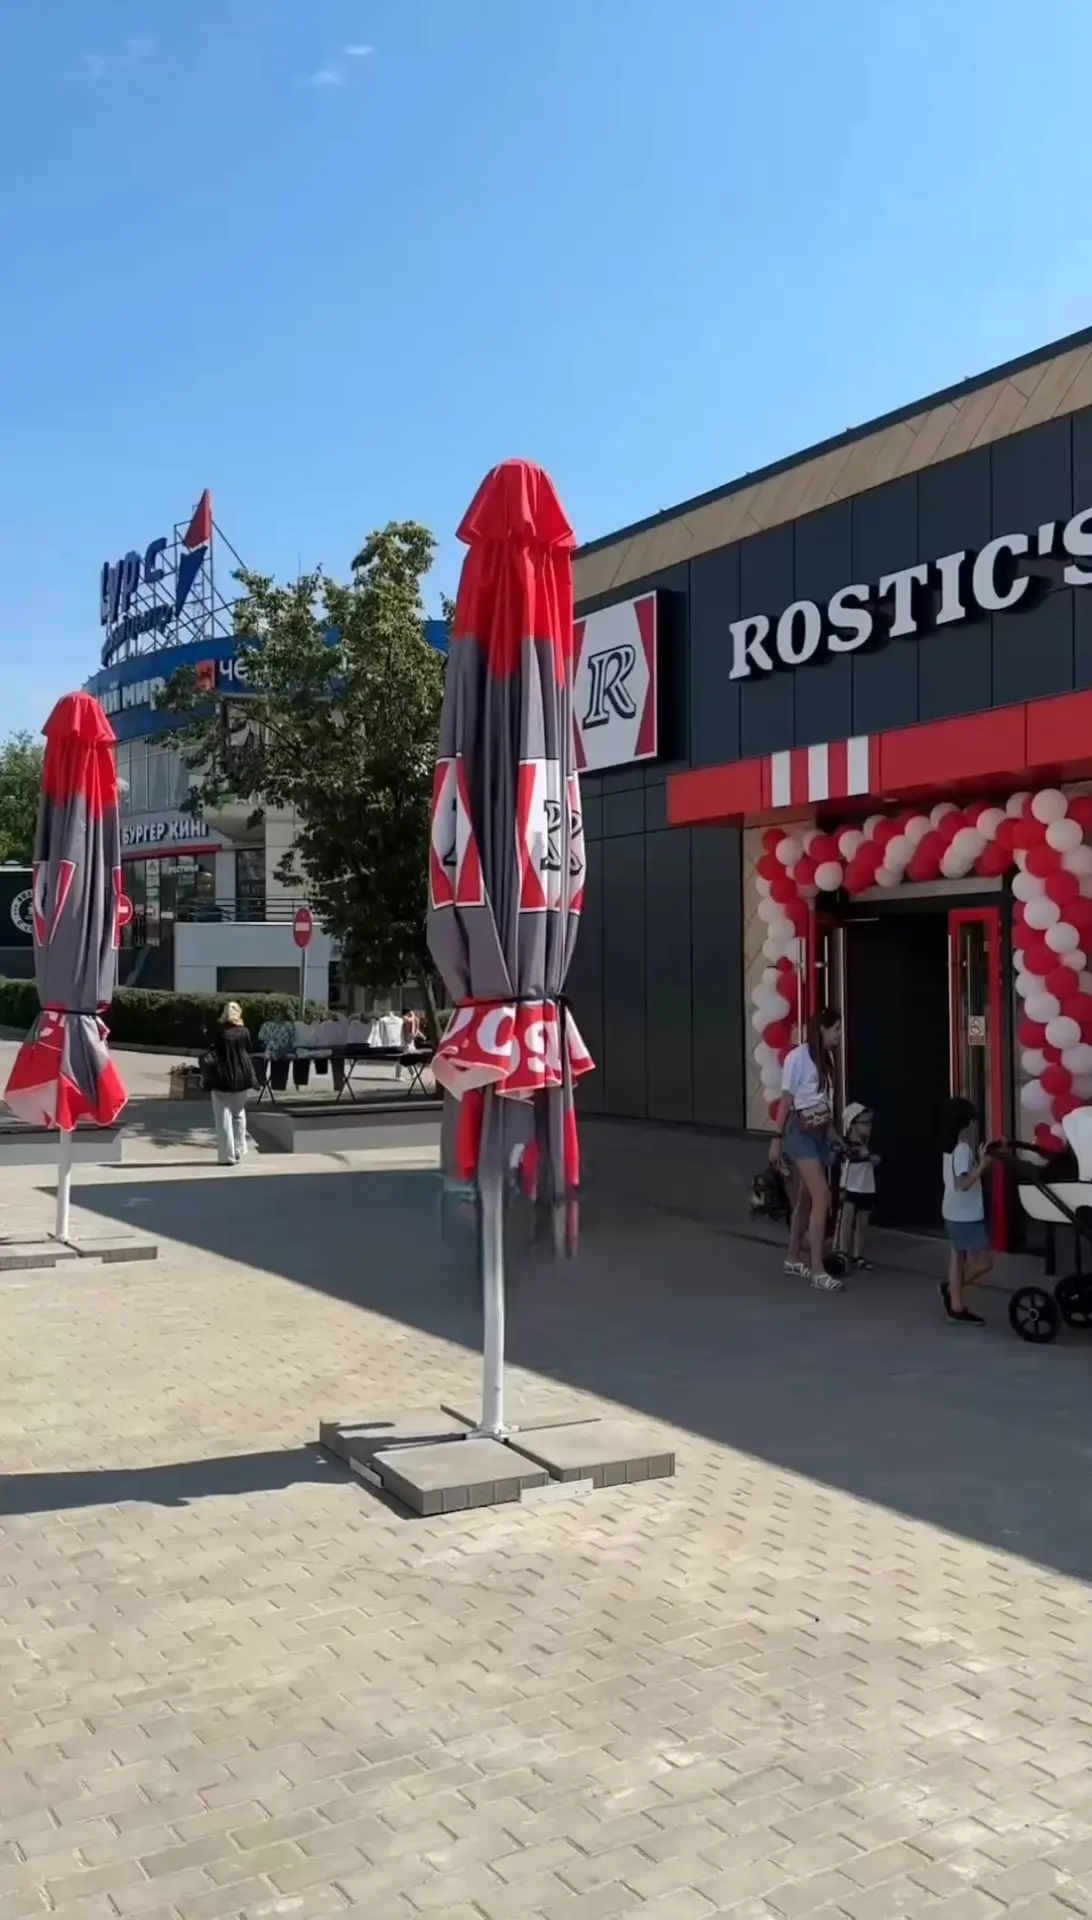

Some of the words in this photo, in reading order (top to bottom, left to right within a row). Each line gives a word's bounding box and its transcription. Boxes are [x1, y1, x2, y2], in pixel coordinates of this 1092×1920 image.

[729, 506, 1092, 681] ROSTIC'S
[582, 644, 636, 730] R
[123, 821, 166, 845] БУРГЕР
